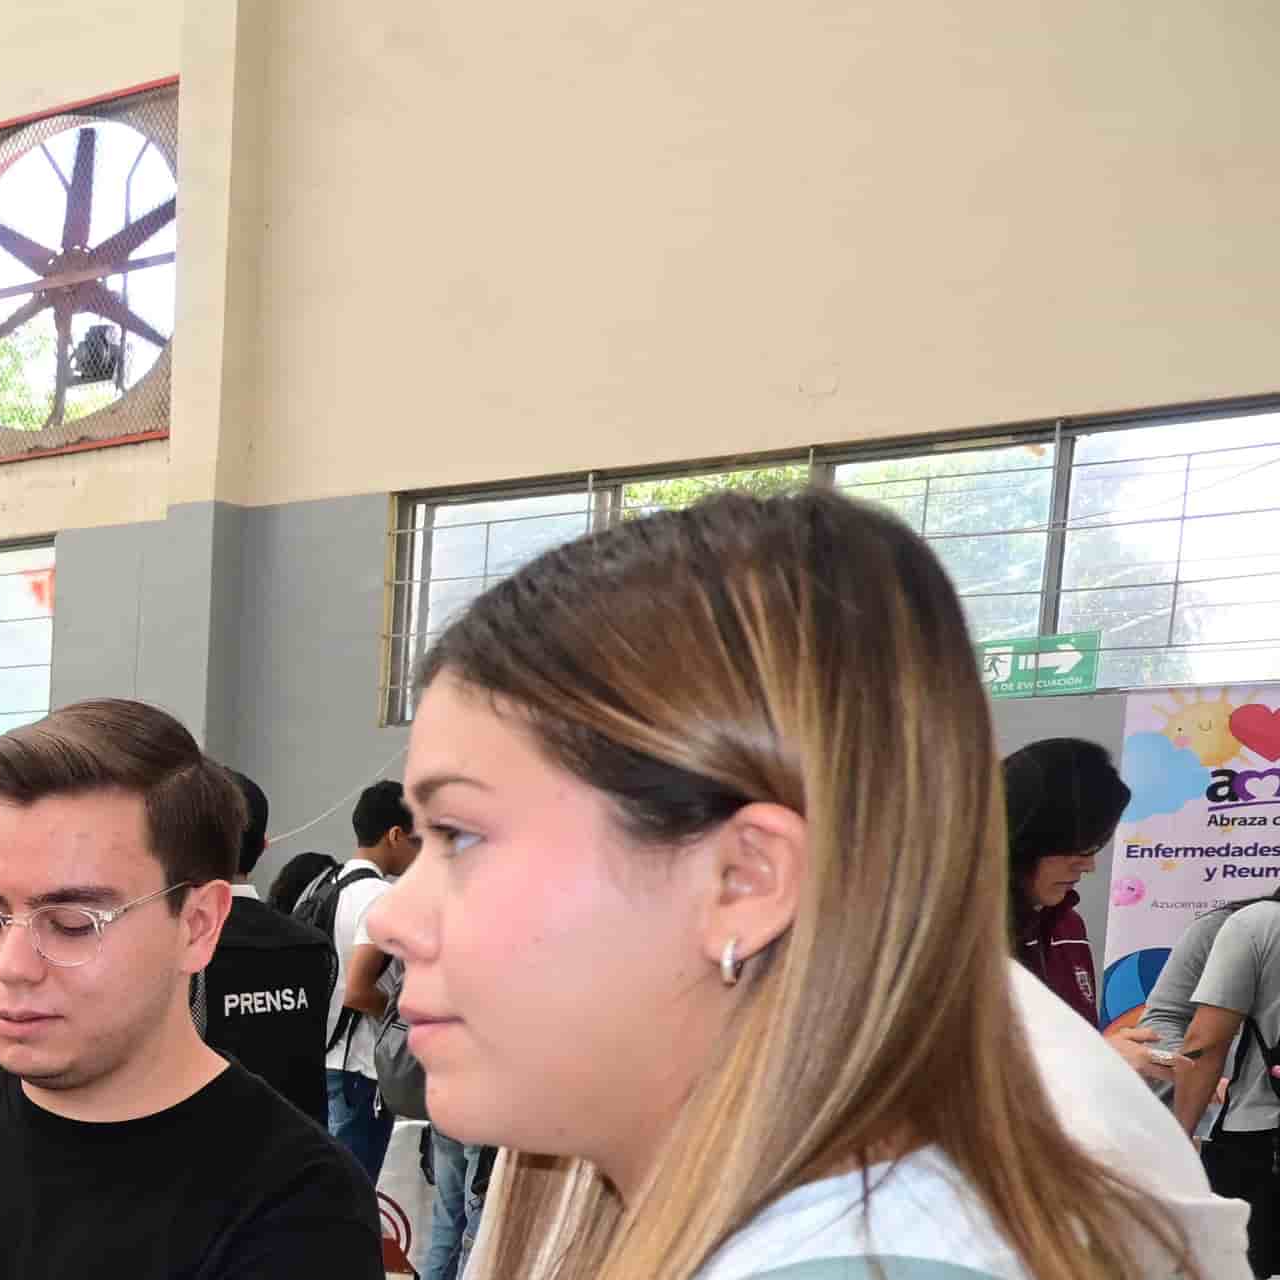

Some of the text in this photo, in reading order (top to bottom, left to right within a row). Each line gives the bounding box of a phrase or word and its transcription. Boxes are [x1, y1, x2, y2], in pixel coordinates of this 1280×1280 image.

[1208, 814, 1267, 827] Abraza
[1126, 842, 1280, 859] Enfermedades
[1203, 866, 1217, 882] y
[224, 987, 308, 1016] PRENSA
